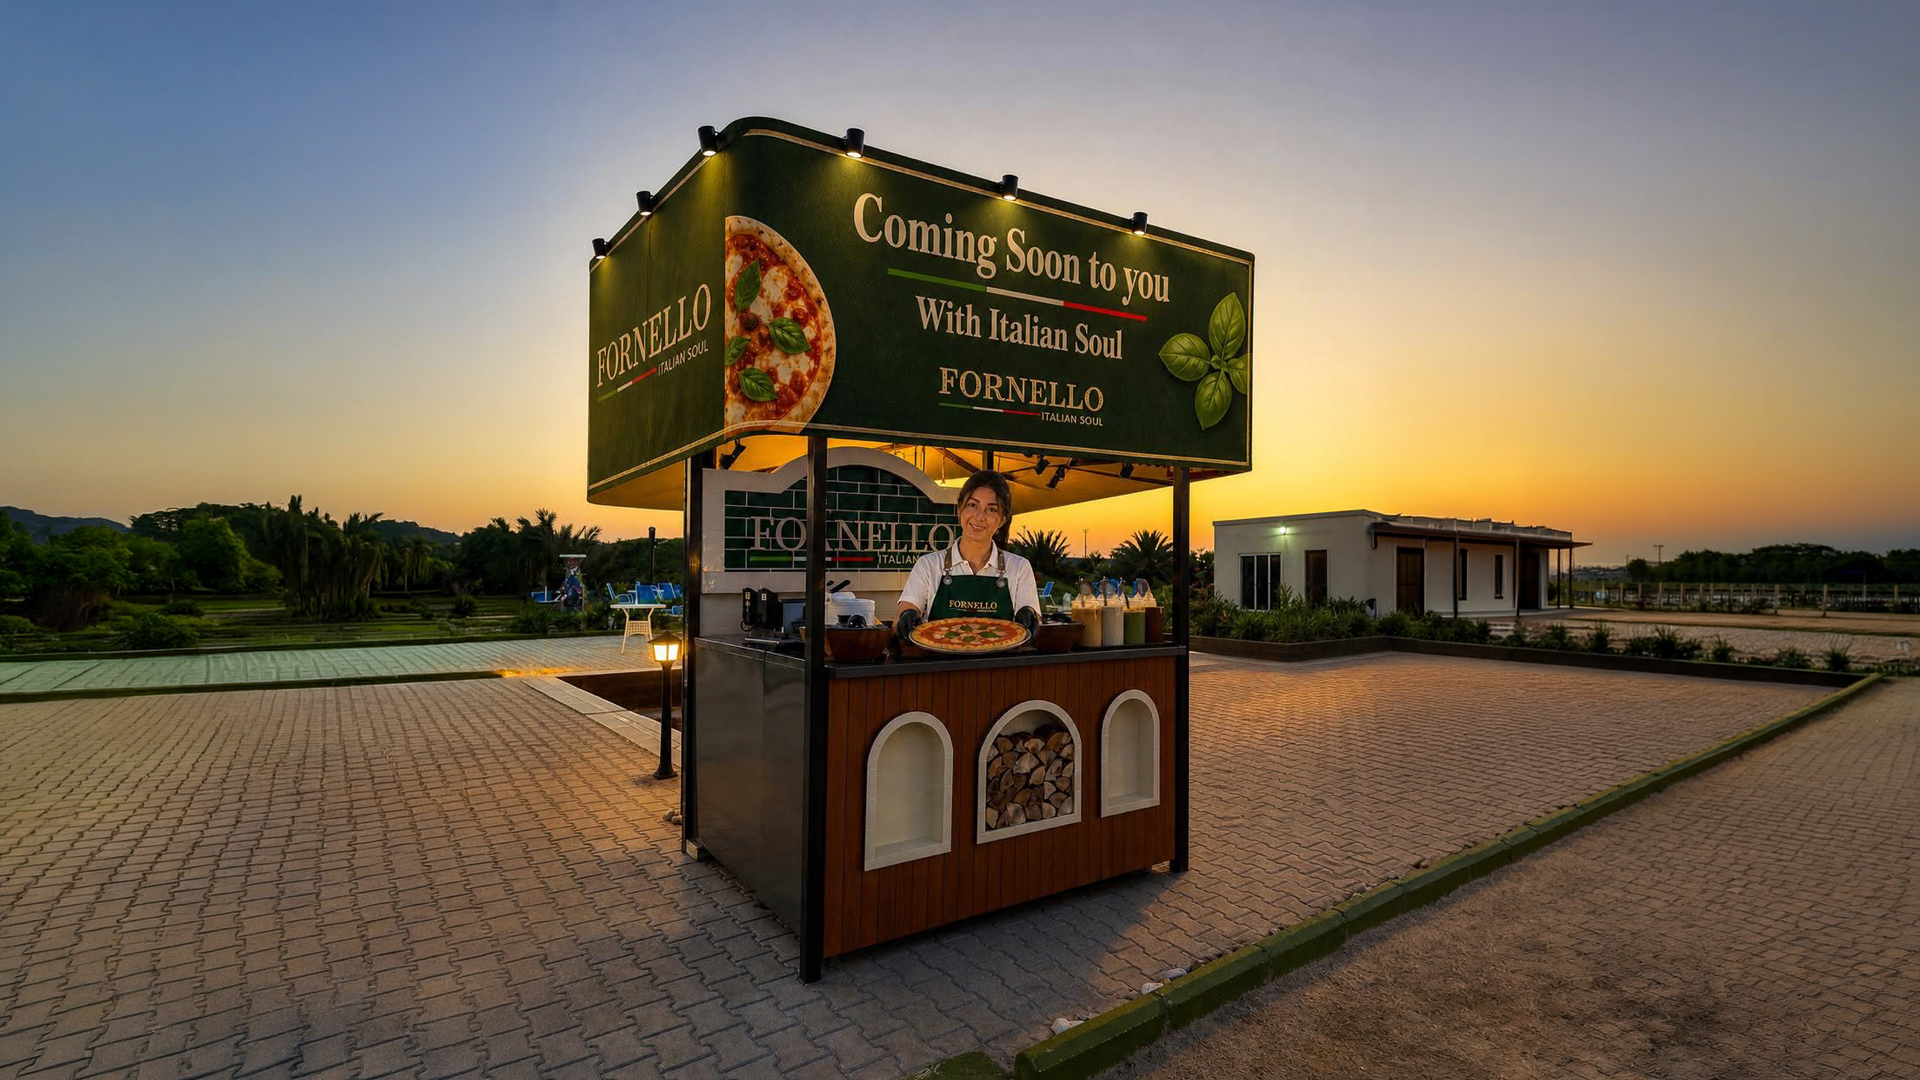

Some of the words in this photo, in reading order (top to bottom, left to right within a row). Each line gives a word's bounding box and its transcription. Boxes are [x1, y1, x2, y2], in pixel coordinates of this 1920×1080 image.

[854, 193, 997, 279] Coming
[1006, 228, 1081, 284] Soon
[1089, 251, 1117, 292] to
[1122, 267, 1169, 306] you
[597, 283, 711, 388] FORNELLO
[915, 296, 981, 338] With
[989, 308, 1068, 351] Italian
[1075, 323, 1123, 359] Soul
[658, 350, 686, 376] ITALIAN
[687, 340, 709, 360] SOUL
[938, 366, 1104, 412] FORNELLO
[1041, 411, 1077, 424] ITALIAN
[1080, 415, 1103, 426] SOUL
[751, 516, 955, 551] FONELLO
[949, 600, 998, 610] FORNELLO
